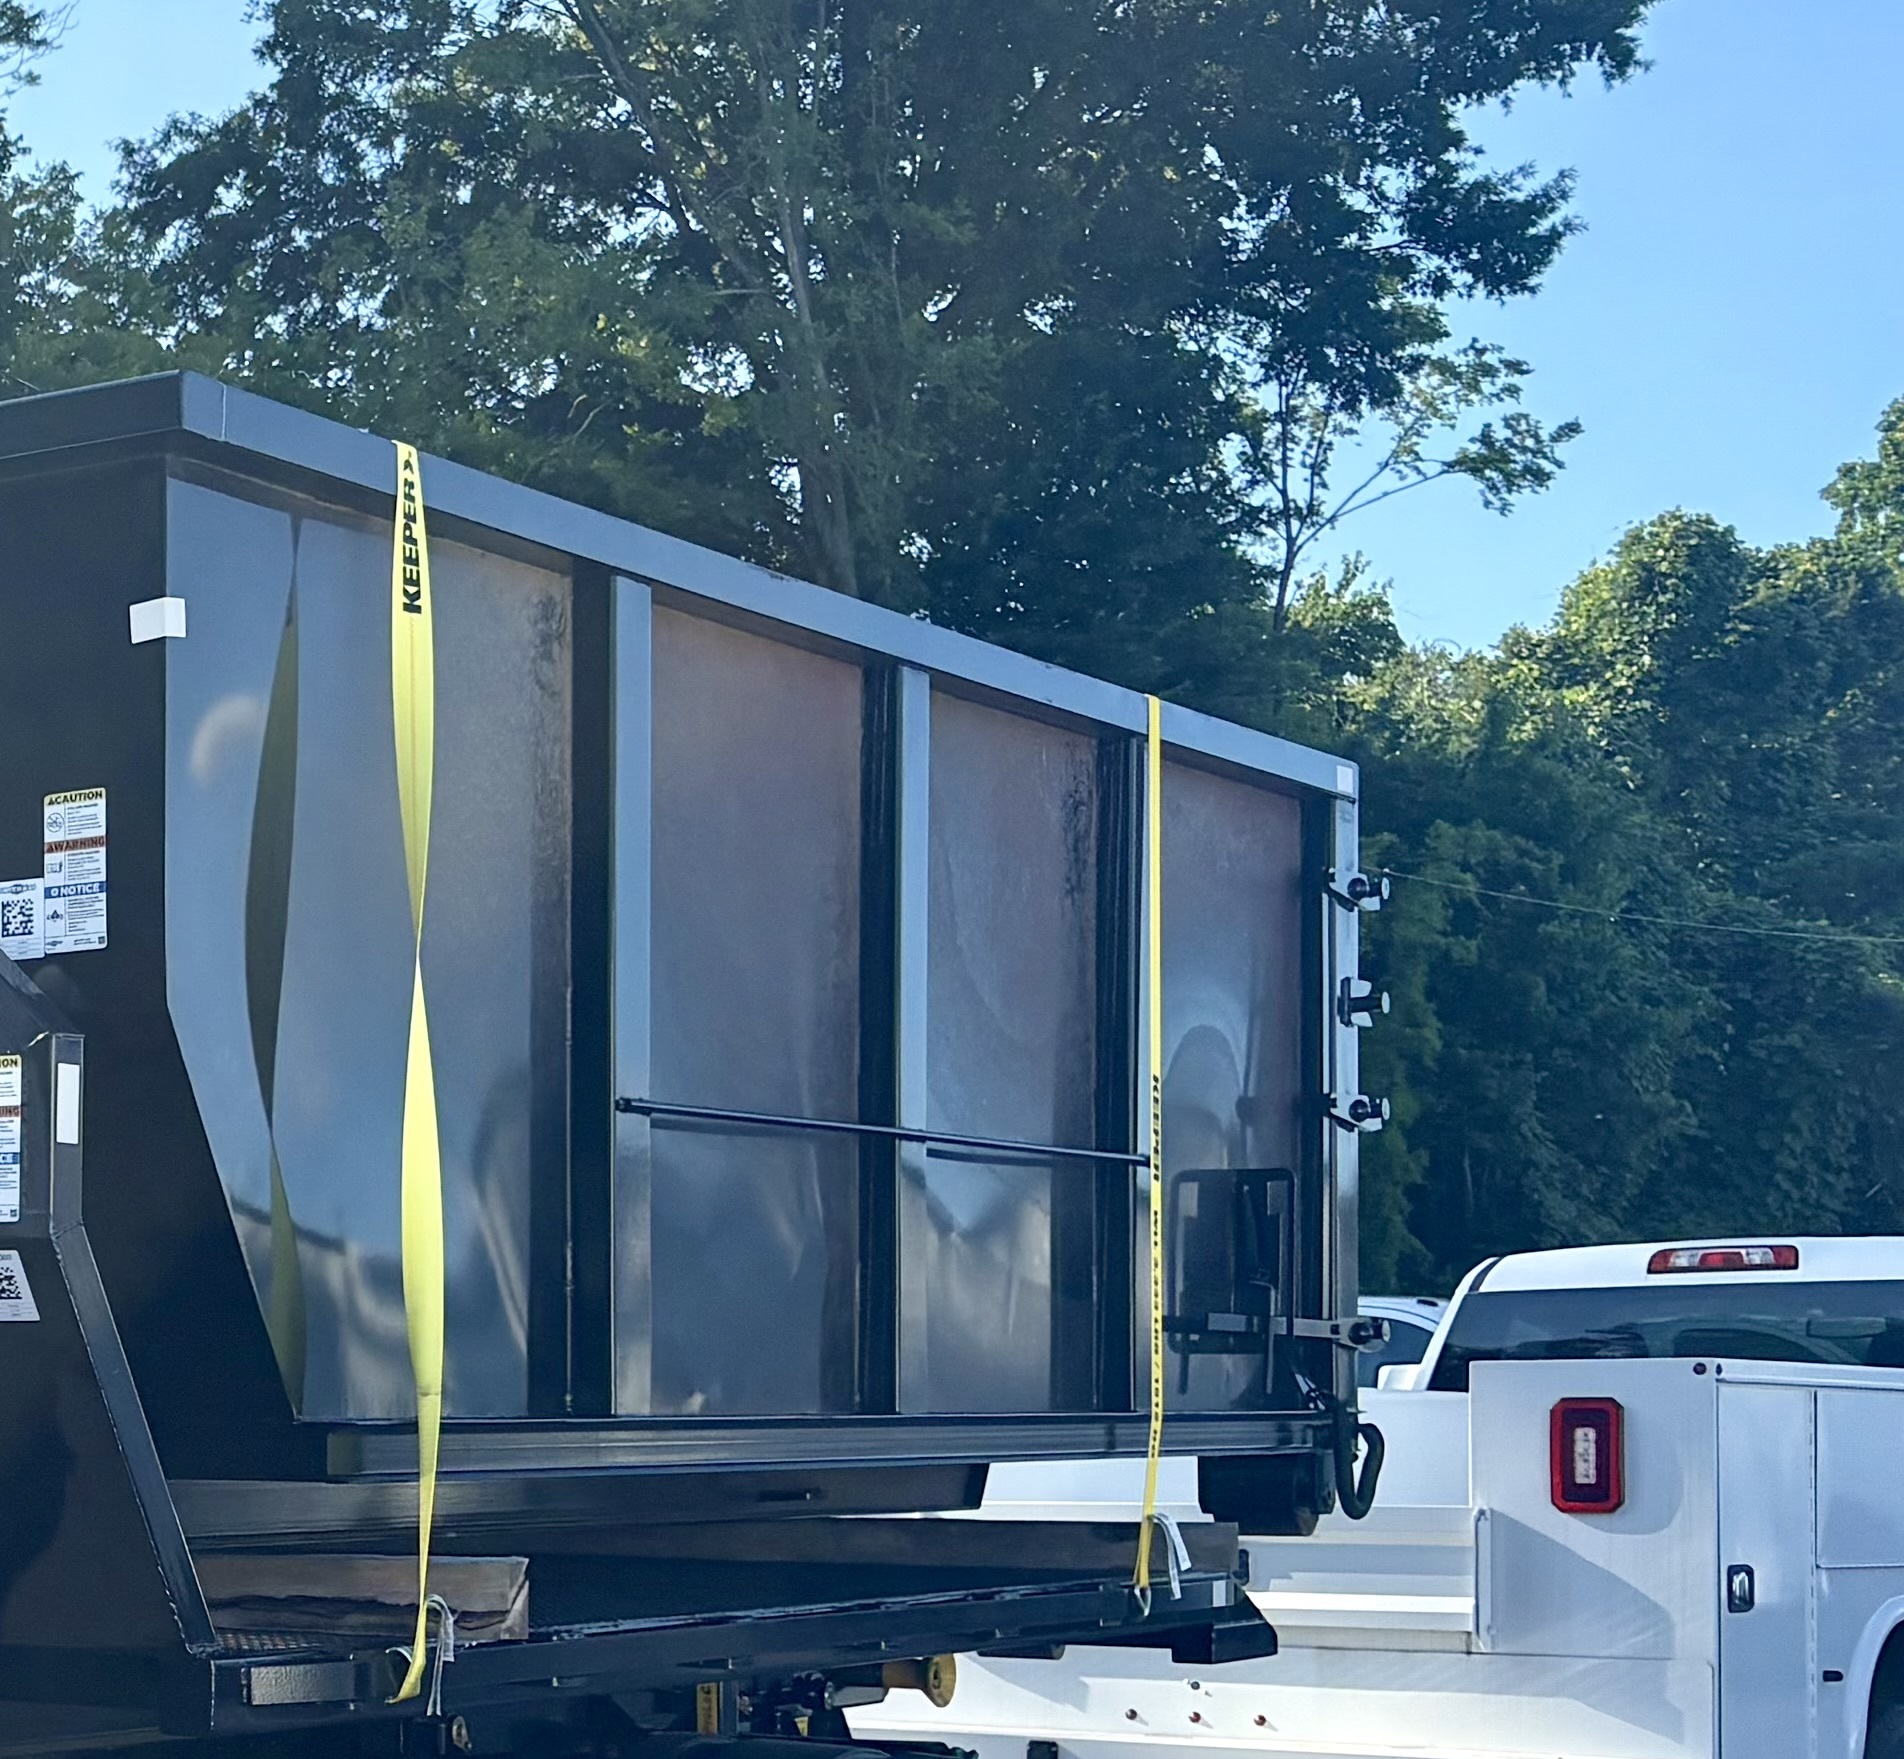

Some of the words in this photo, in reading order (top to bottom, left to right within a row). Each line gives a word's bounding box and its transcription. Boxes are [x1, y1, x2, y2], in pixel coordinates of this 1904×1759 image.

[403, 478, 422, 614] KEEPER
[55, 790, 103, 804] CAUTION
[52, 836, 105, 852] WARNING
[59, 882, 101, 897] NOTICE
